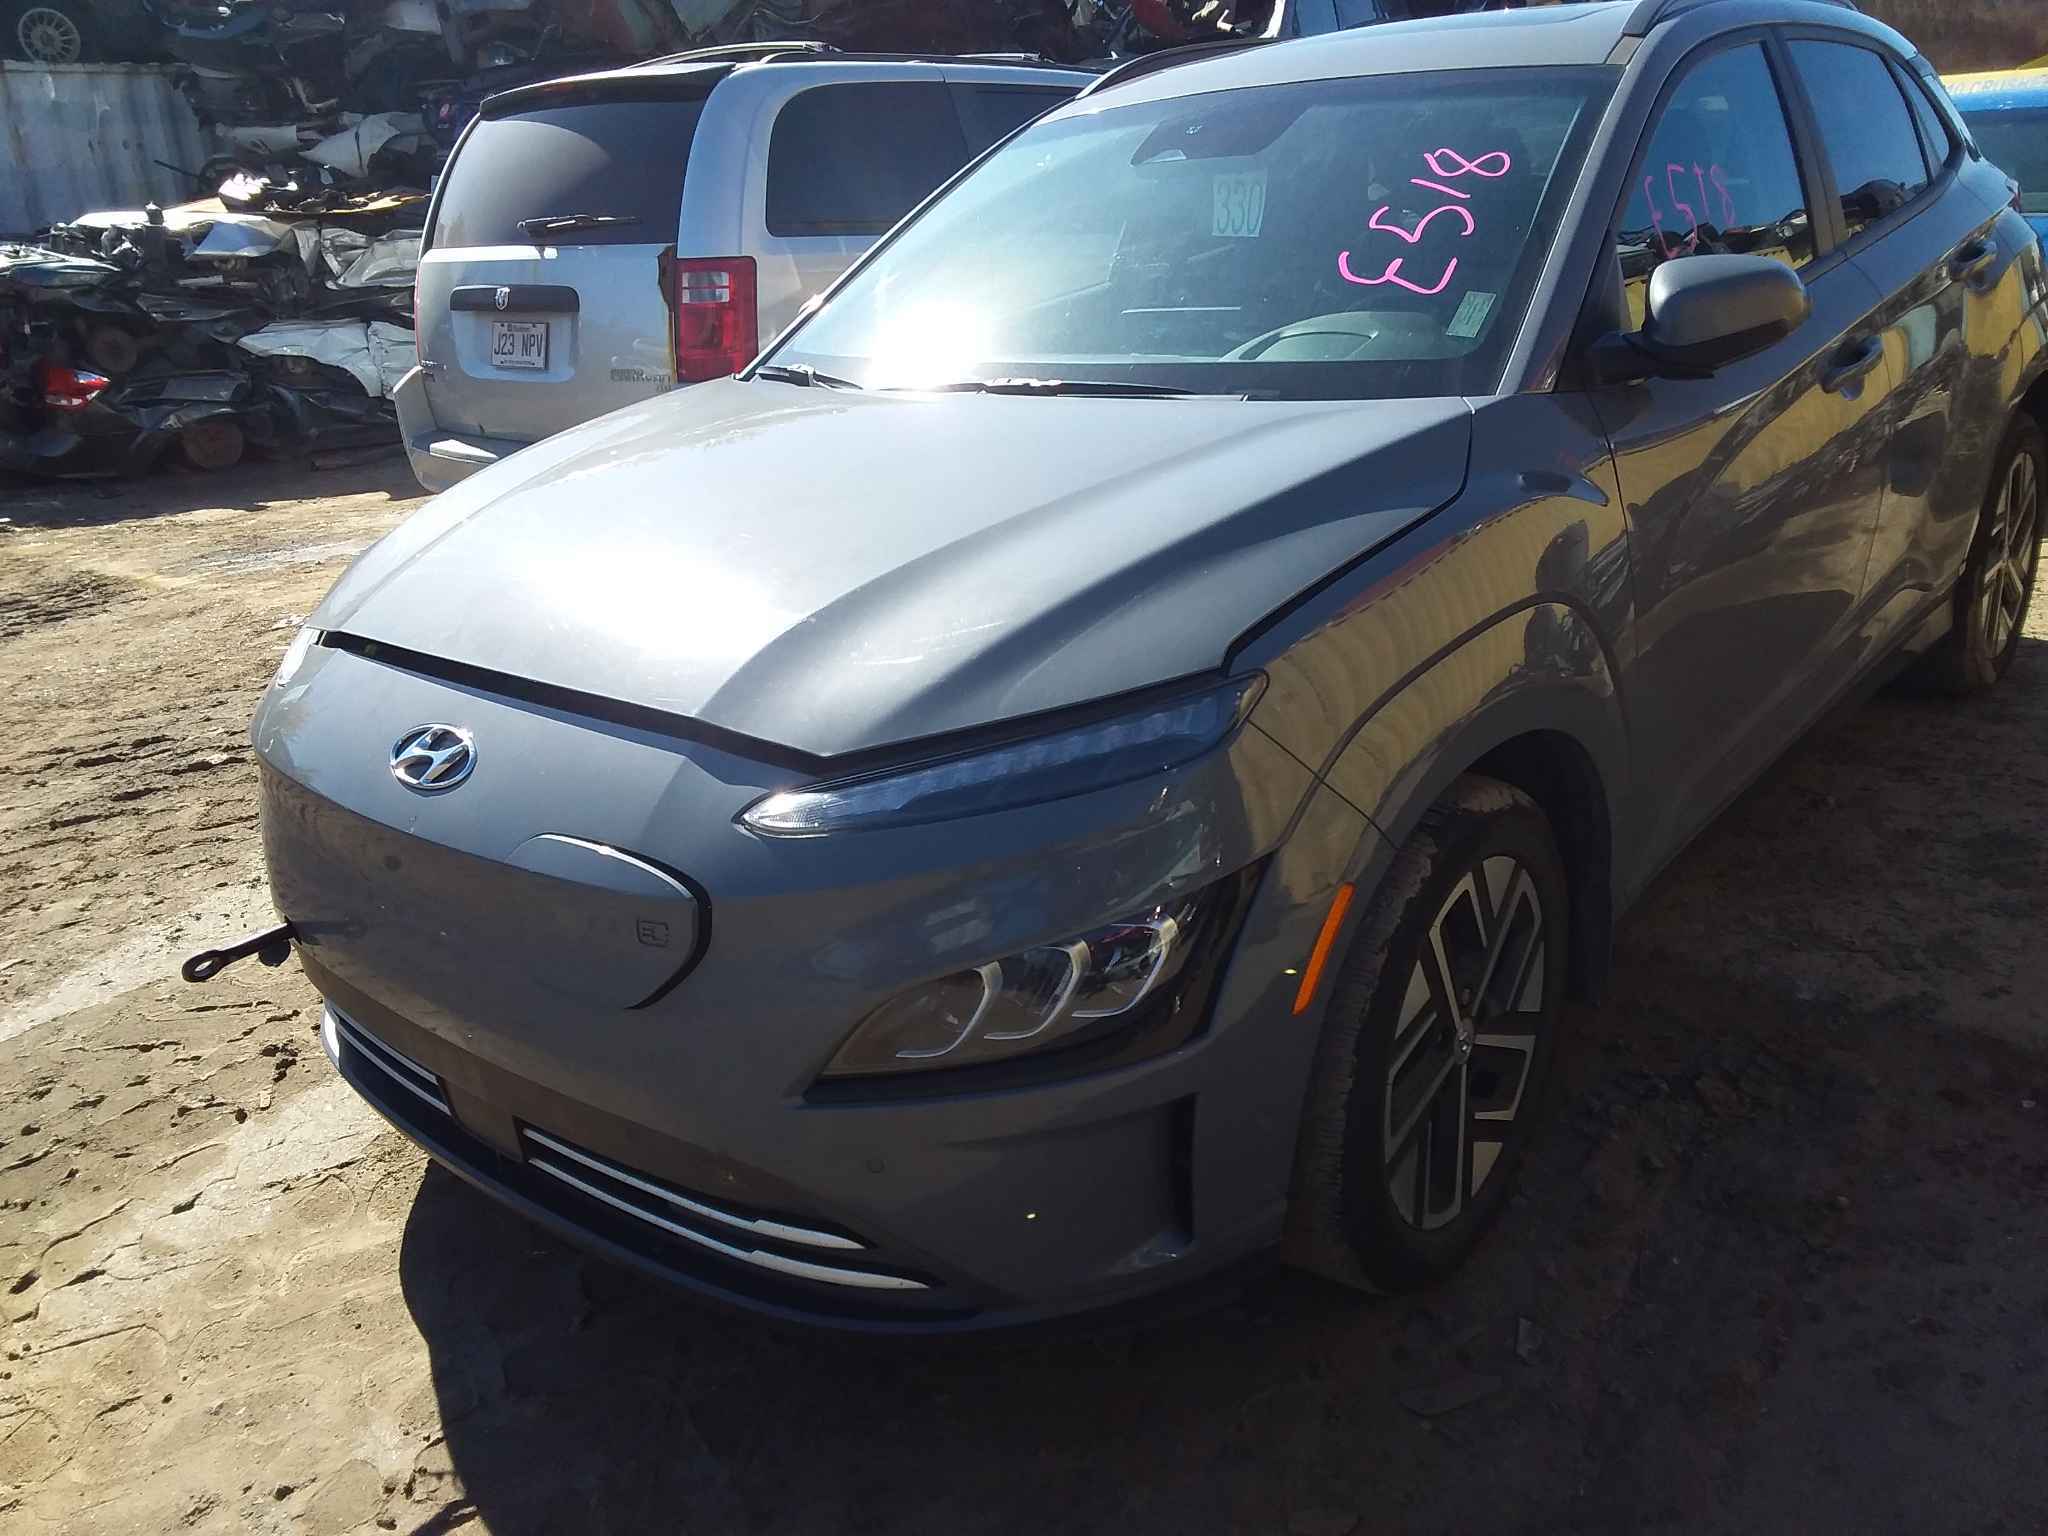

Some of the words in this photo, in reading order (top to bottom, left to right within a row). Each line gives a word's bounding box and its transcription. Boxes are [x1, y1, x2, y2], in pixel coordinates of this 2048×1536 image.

[1337, 148, 1511, 294] E518
[494, 332, 515, 355] J23
[521, 333, 543, 357] NPV
